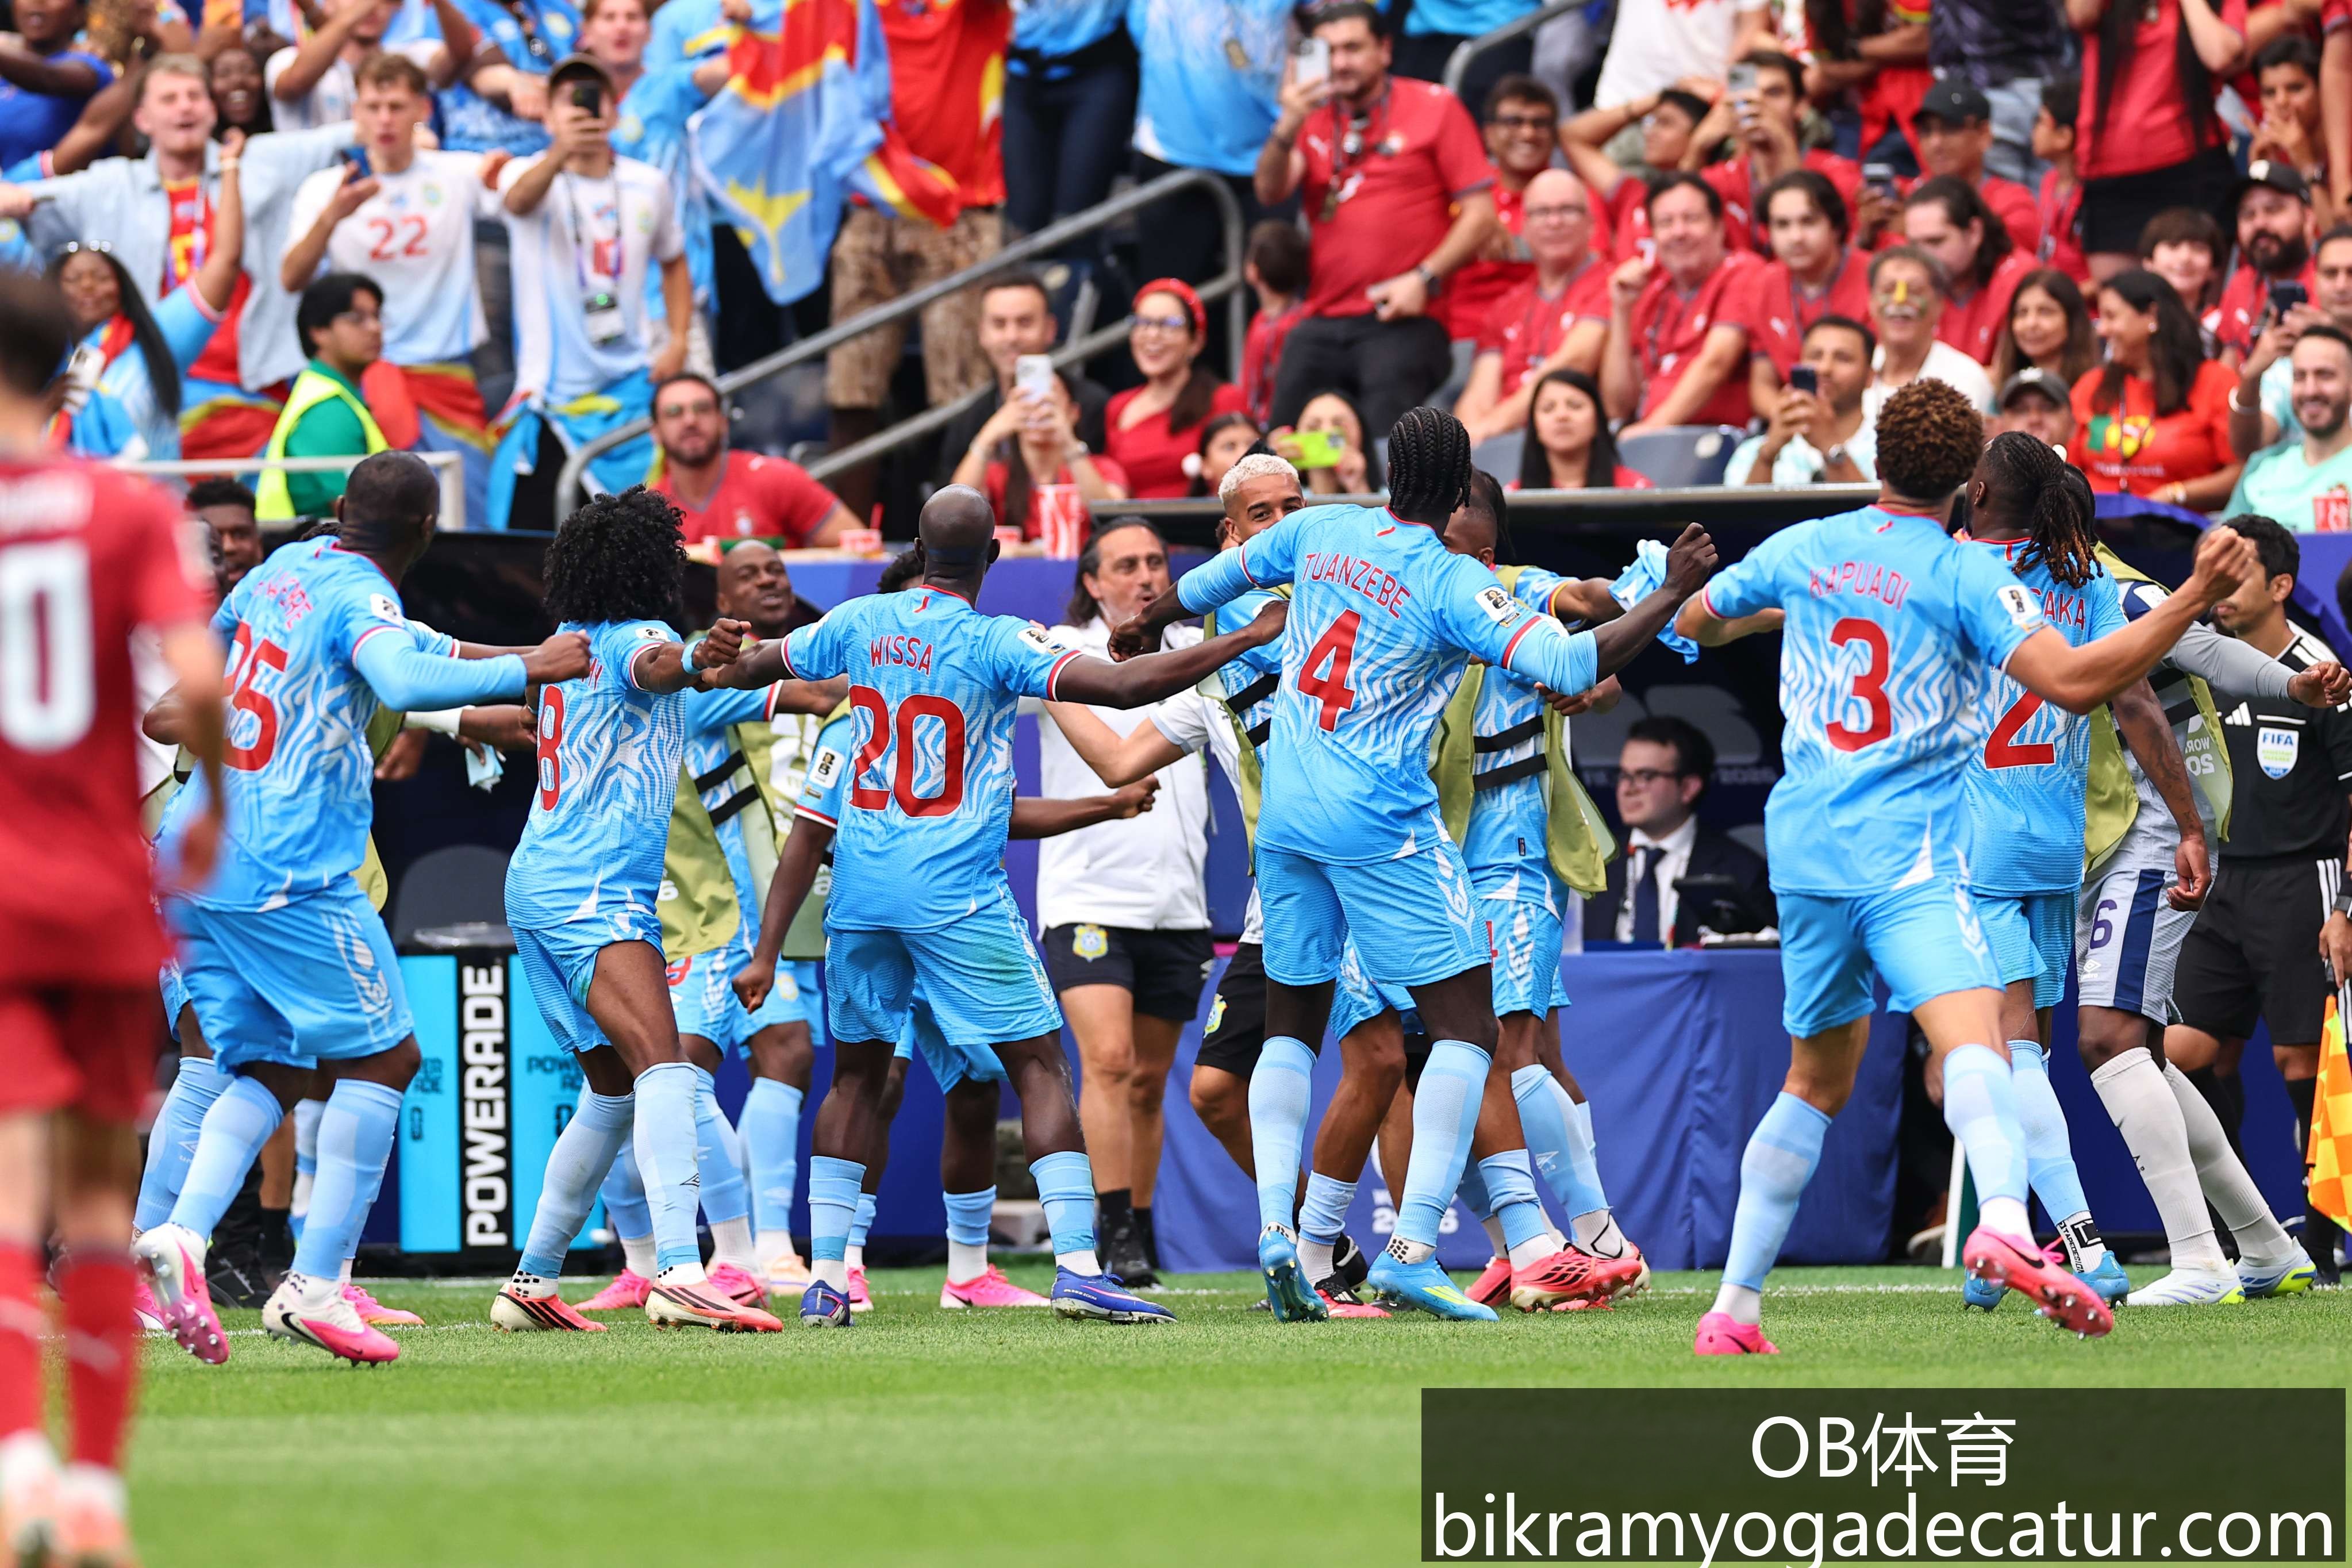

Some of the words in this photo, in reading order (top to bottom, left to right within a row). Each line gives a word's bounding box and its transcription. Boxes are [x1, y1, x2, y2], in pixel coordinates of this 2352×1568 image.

[368, 216, 428, 262] 22
[1301, 551, 1412, 621] TUANZEBE
[1809, 561, 1912, 612] KAPUADI
[870, 635, 933, 677] WISSA
[1297, 609, 1362, 733] 4
[1825, 617, 1892, 752] 3
[537, 684, 564, 812] 8
[848, 685, 966, 818] 20
[1983, 689, 2057, 770] 2
[2262, 733, 2294, 746] FIFA
[2089, 898, 2118, 950] 6
[462, 964, 508, 1247] POWERADE
